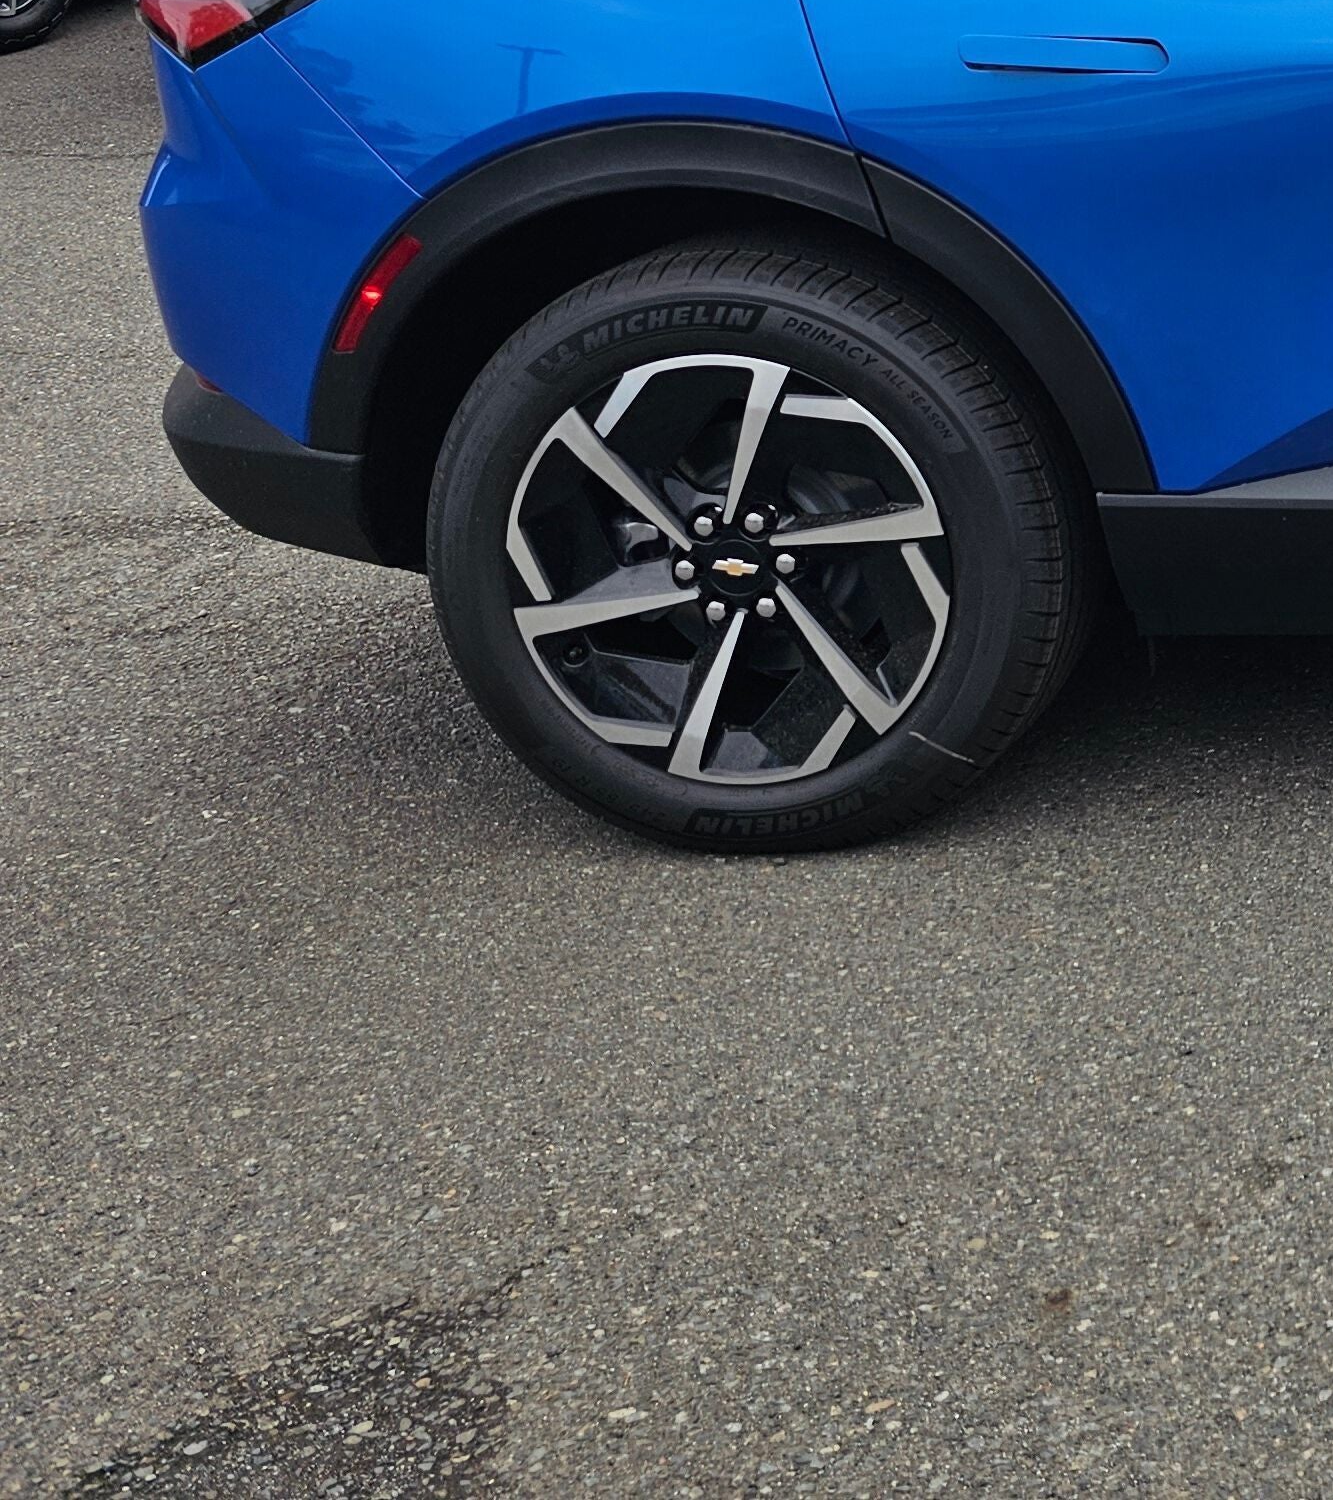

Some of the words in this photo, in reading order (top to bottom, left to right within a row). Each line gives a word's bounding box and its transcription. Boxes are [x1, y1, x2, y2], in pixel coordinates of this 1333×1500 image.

[583, 305, 755, 352] MICHELIN
[782, 316, 879, 367] PRIMACY
[880, 369, 906, 389] ALL
[906, 389, 954, 440] SEASON
[692, 789, 865, 836] MICHELIN
